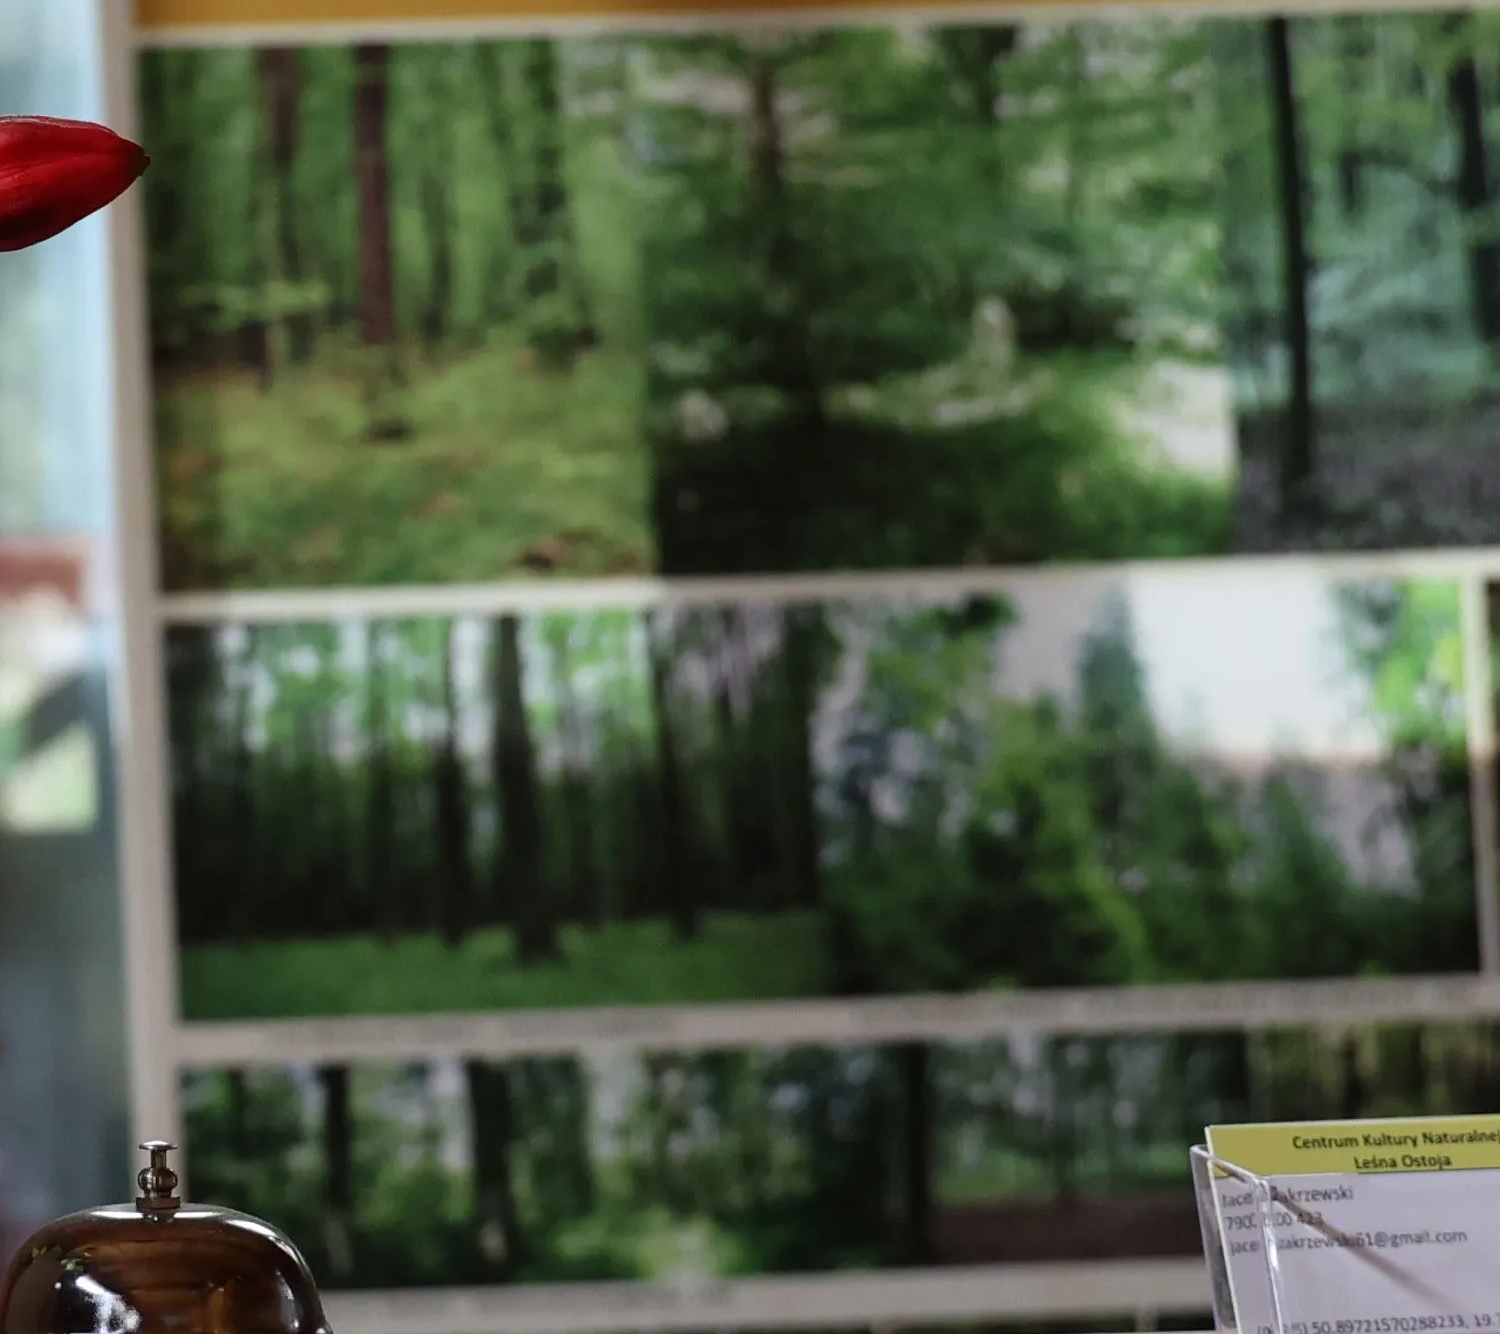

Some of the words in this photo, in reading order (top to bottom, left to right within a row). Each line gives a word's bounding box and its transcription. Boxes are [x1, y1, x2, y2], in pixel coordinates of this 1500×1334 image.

[1293, 1135, 1358, 1149] Centrum
[1363, 1133, 1418, 1148] Kultury
[1355, 1154, 1396, 1169] Leśna
[1402, 1155, 1451, 1170] Ostoja
